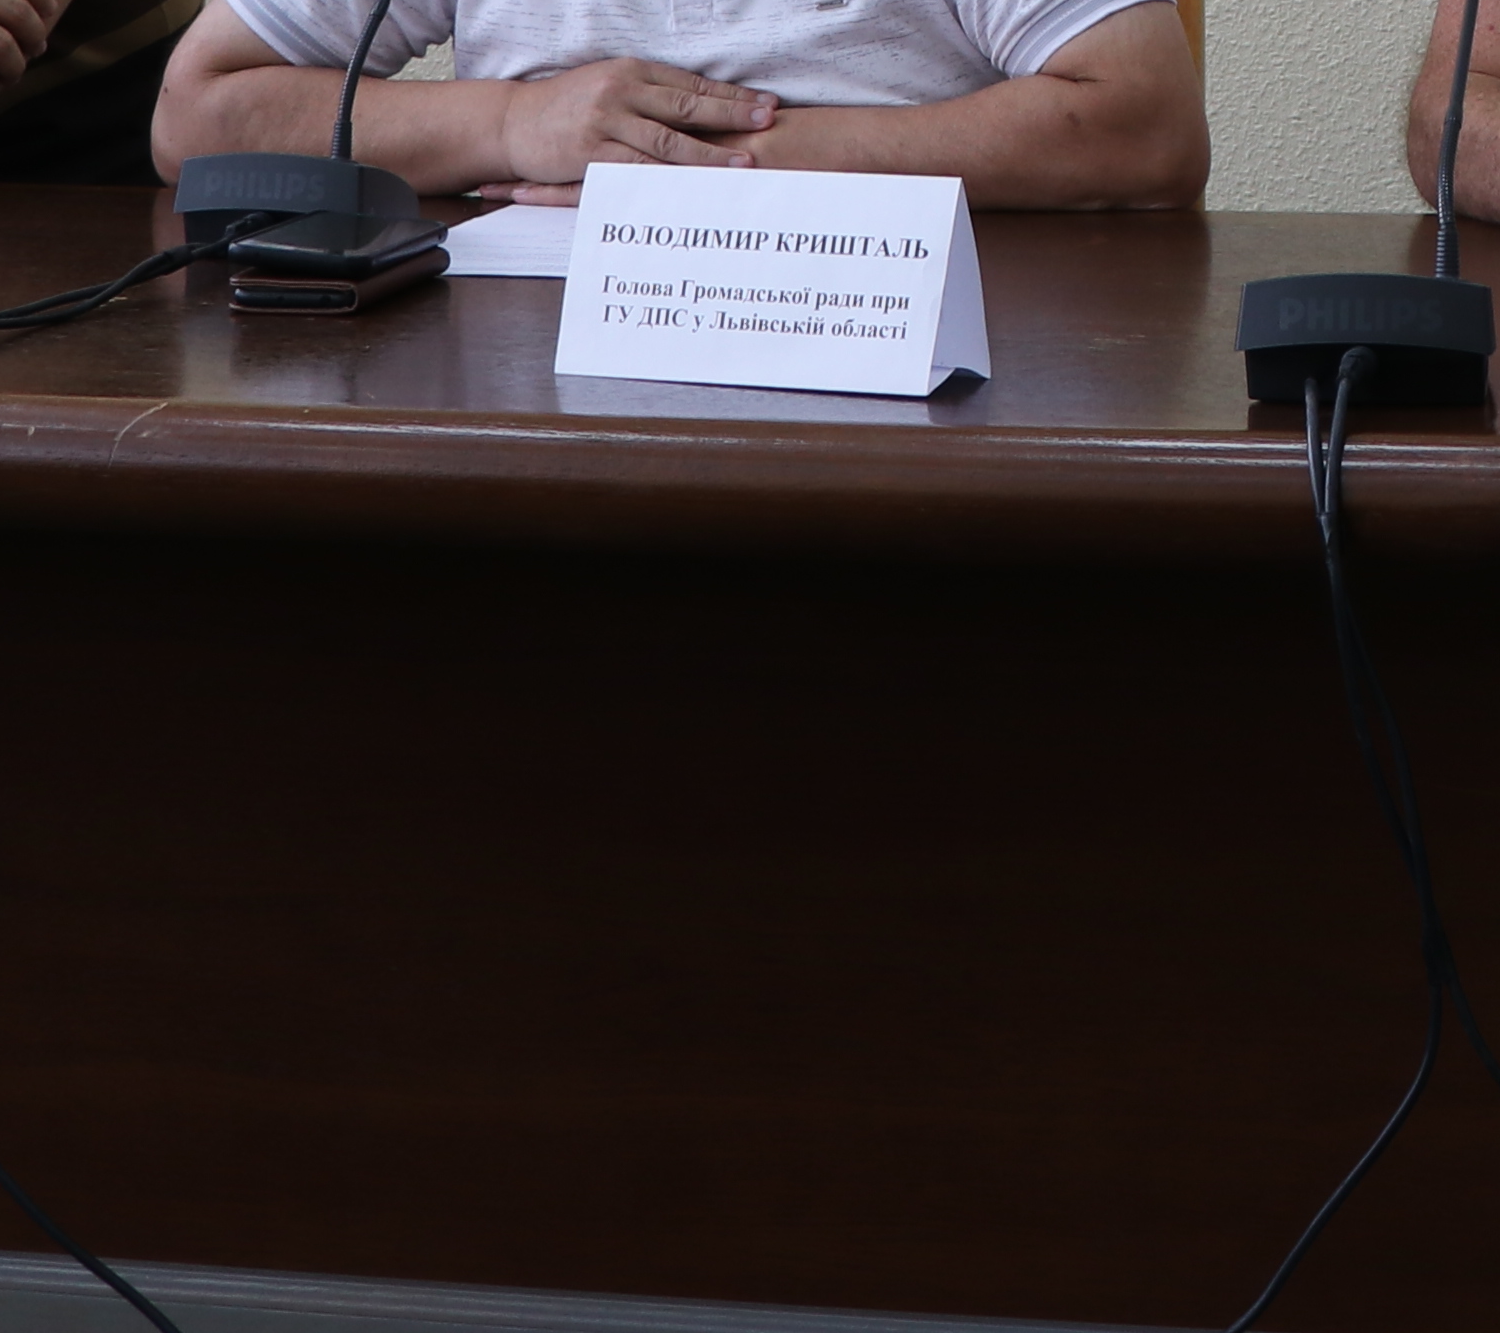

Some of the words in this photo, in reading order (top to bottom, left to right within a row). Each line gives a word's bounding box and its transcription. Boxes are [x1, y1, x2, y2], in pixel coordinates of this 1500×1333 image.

[203, 169, 325, 202] PHILIPS
[601, 223, 770, 251] ВОЛОДИМИР
[775, 232, 929, 259] КРИШТАЛЬ
[602, 275, 674, 297] Голова
[680, 279, 810, 305] Громадської
[814, 292, 865, 311] ради
[871, 295, 910, 315] при
[603, 304, 634, 324] ГУ
[636, 306, 689, 328] ДПС
[691, 314, 705, 334] у
[708, 311, 825, 336] Львівській
[831, 318, 908, 340] області
[1279, 297, 1443, 332] PHILIPS
